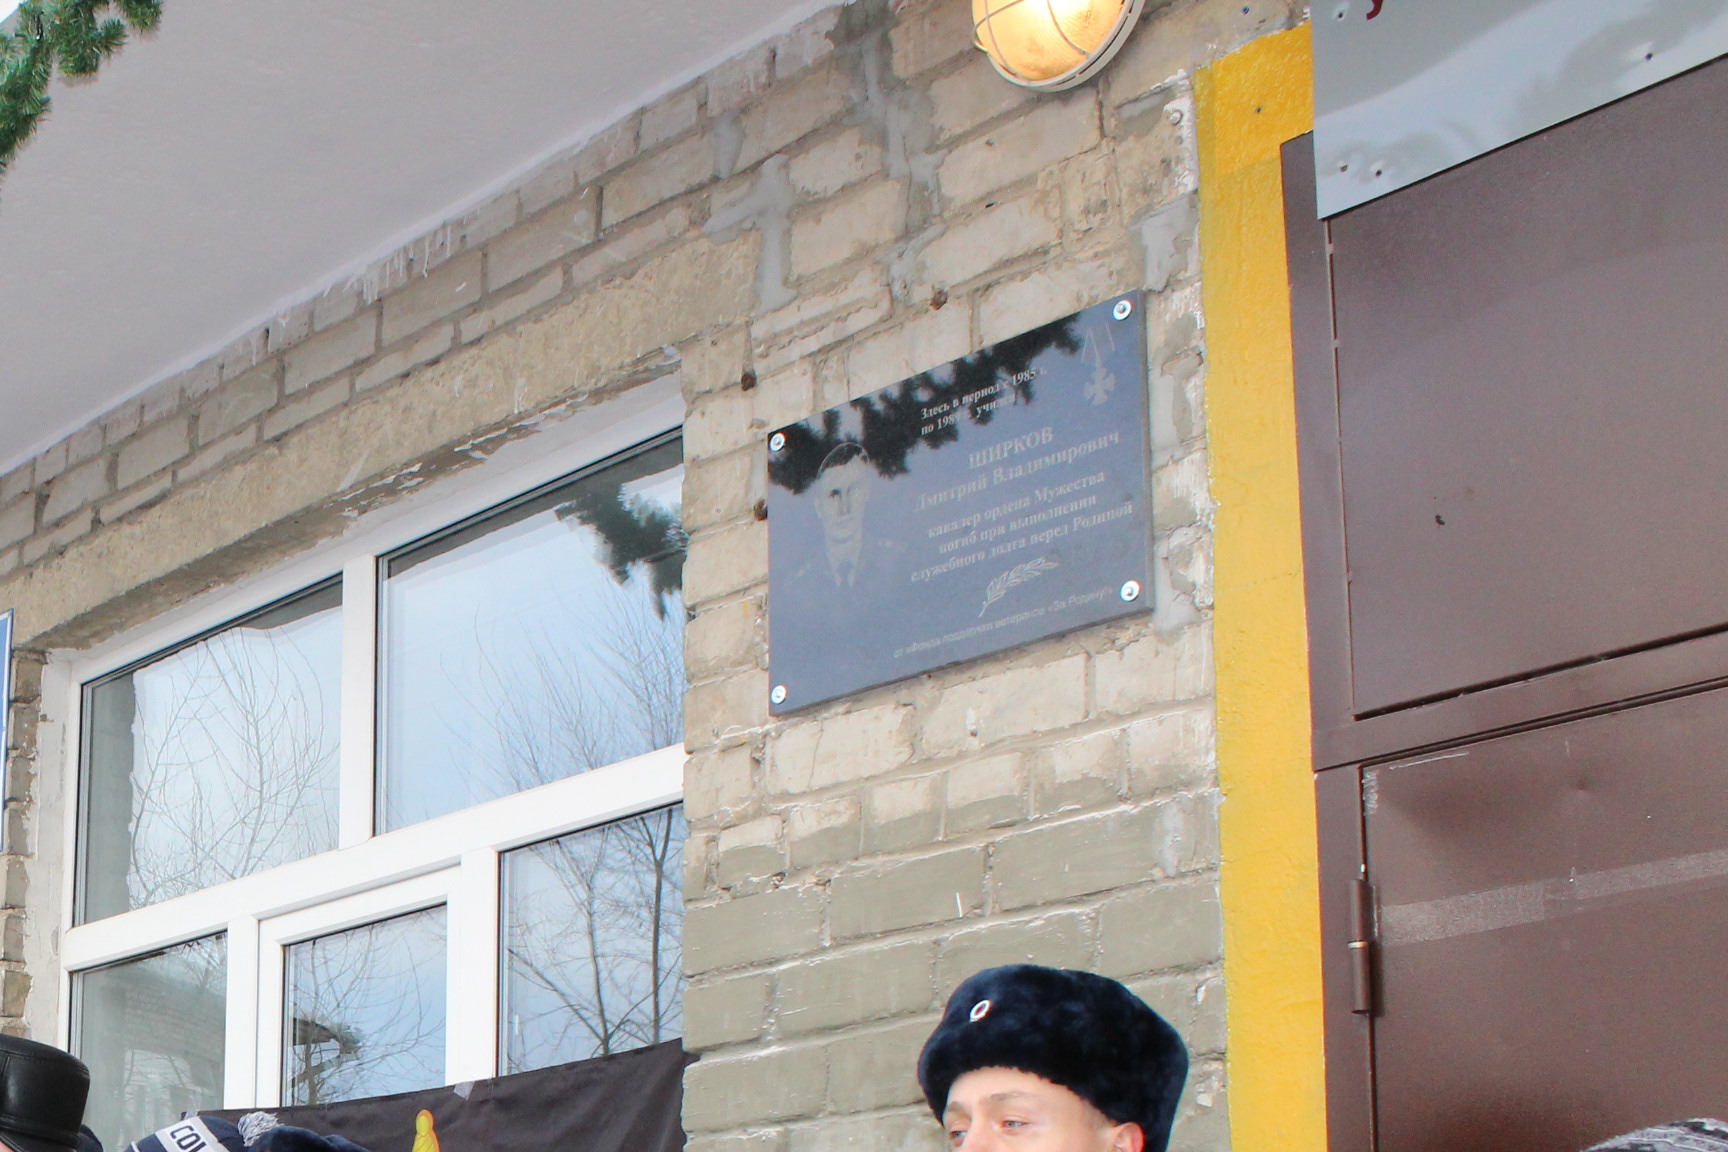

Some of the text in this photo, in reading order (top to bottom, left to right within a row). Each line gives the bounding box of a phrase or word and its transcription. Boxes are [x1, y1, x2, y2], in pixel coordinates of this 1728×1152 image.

[920, 403, 950, 420] Здесь
[962, 383, 1000, 403] период
[1012, 368, 1037, 386] 1985
[921, 424, 934, 436] по
[969, 426, 1054, 469] ШИРКОВ
[916, 431, 1120, 512] Дмитрий Владимирович
[928, 471, 1105, 538] кавалер ордена Мужества
[939, 495, 1097, 554] погиб при выполнении
[911, 500, 1133, 582] служебного долга перед Родиной
